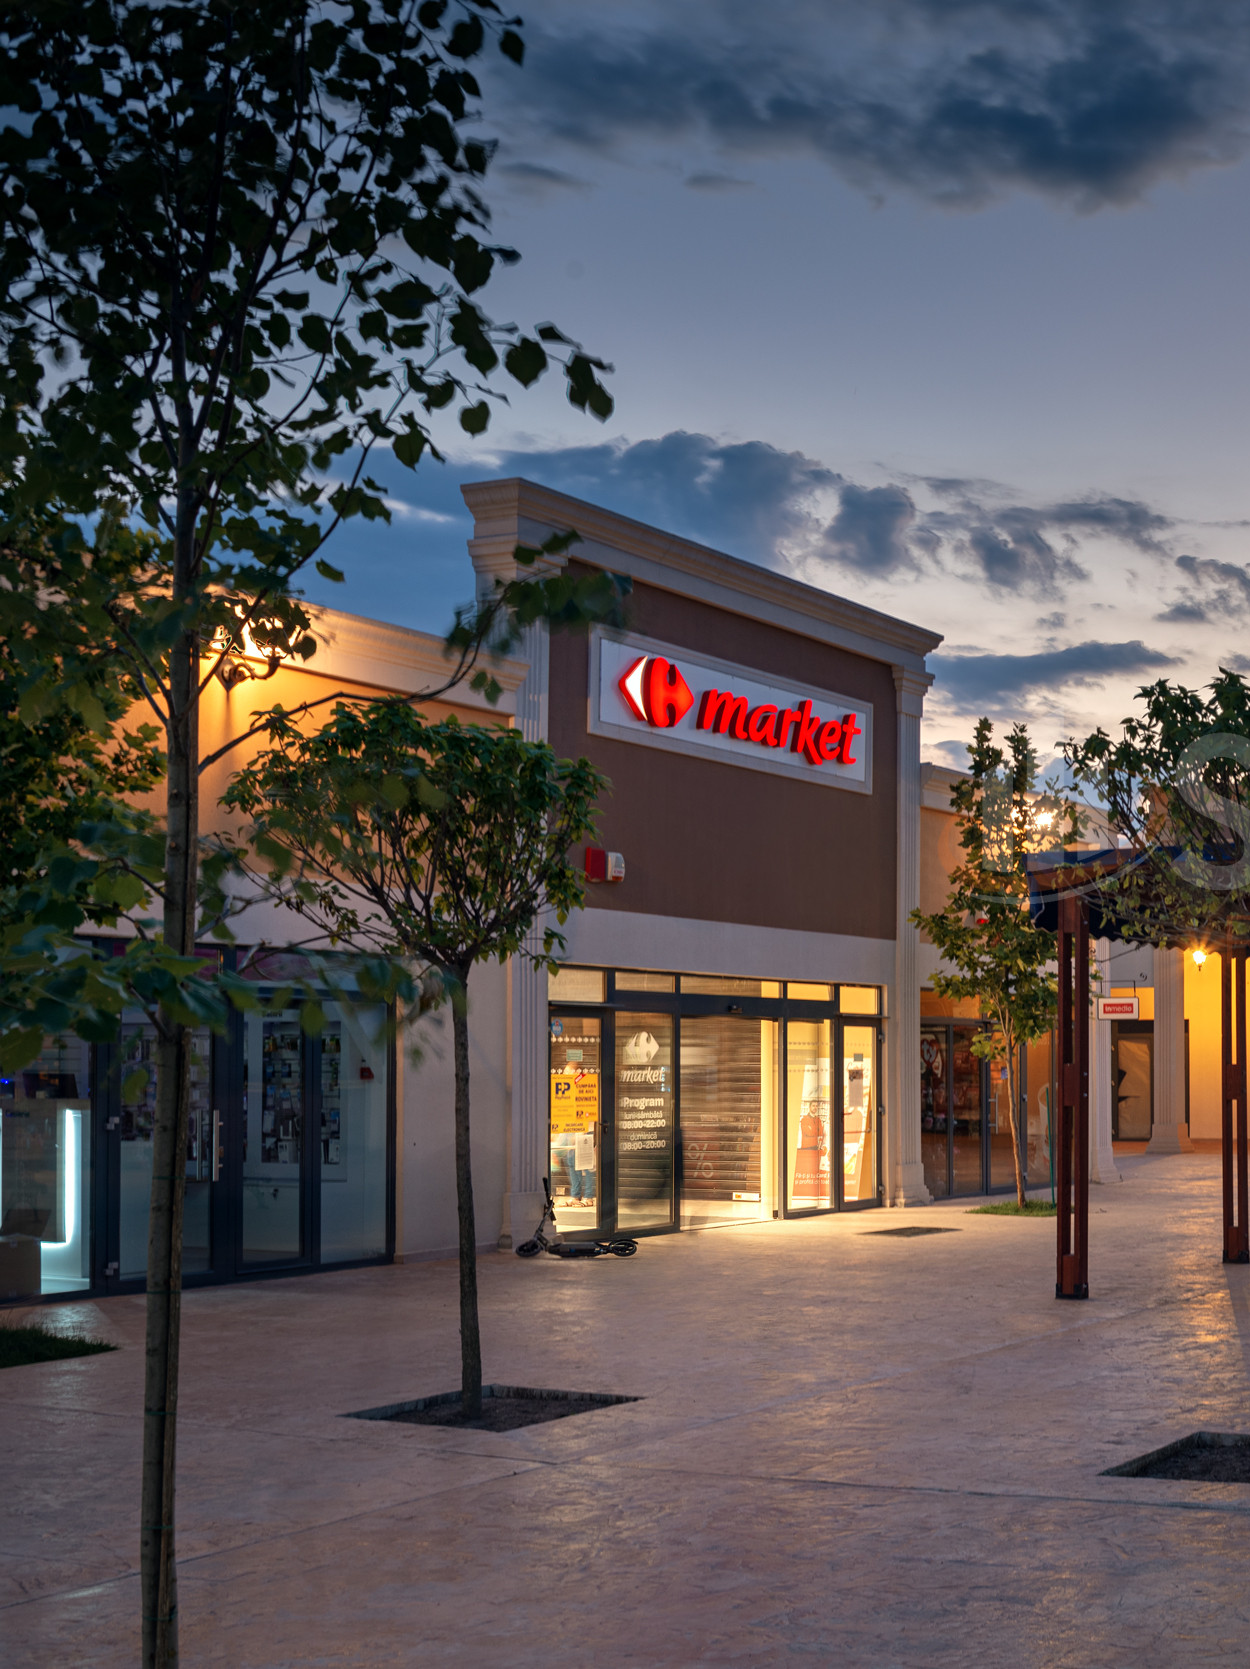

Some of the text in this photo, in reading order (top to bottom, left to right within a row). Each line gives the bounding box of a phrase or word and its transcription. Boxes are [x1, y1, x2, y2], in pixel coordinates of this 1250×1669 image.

[697, 688, 862, 766] market
[622, 1066, 664, 1084] market
[624, 1097, 664, 1109] Program
